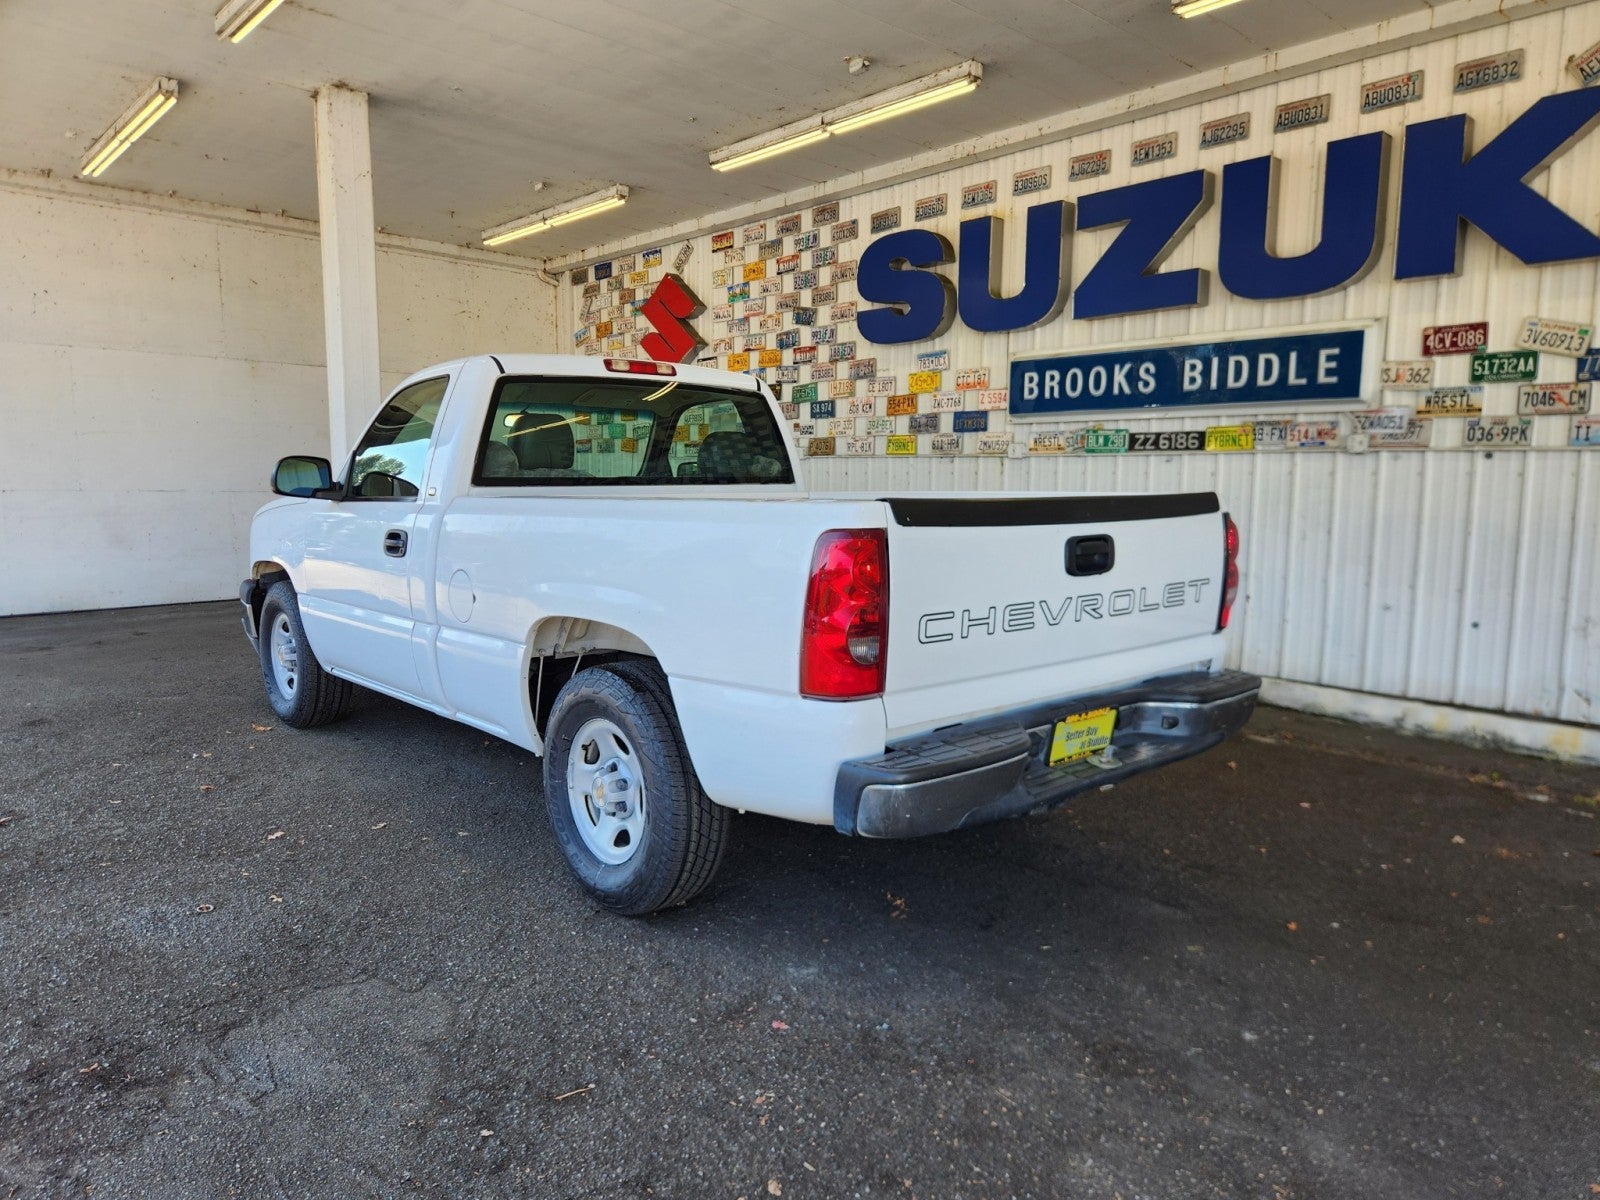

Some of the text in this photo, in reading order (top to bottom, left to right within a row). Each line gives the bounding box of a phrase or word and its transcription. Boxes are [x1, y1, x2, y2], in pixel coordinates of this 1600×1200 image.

[1457, 60, 1519, 88] AGY6832
[1363, 81, 1416, 108] ABU0831
[1276, 104, 1324, 128] ABU0831
[1522, 328, 1586, 353] 3V60913
[1023, 348, 1341, 400] BROOKS BIDDLE
[1406, 367, 1431, 384] 362
[1473, 356, 1535, 376] 51732AA
[822, 402, 832, 413] 974
[1424, 393, 1475, 410] WRESTL
[1523, 389, 1587, 408] 7046 CM
[1134, 430, 1200, 450] ZZ 6186
[917, 577, 1211, 645] CHEVROLET
